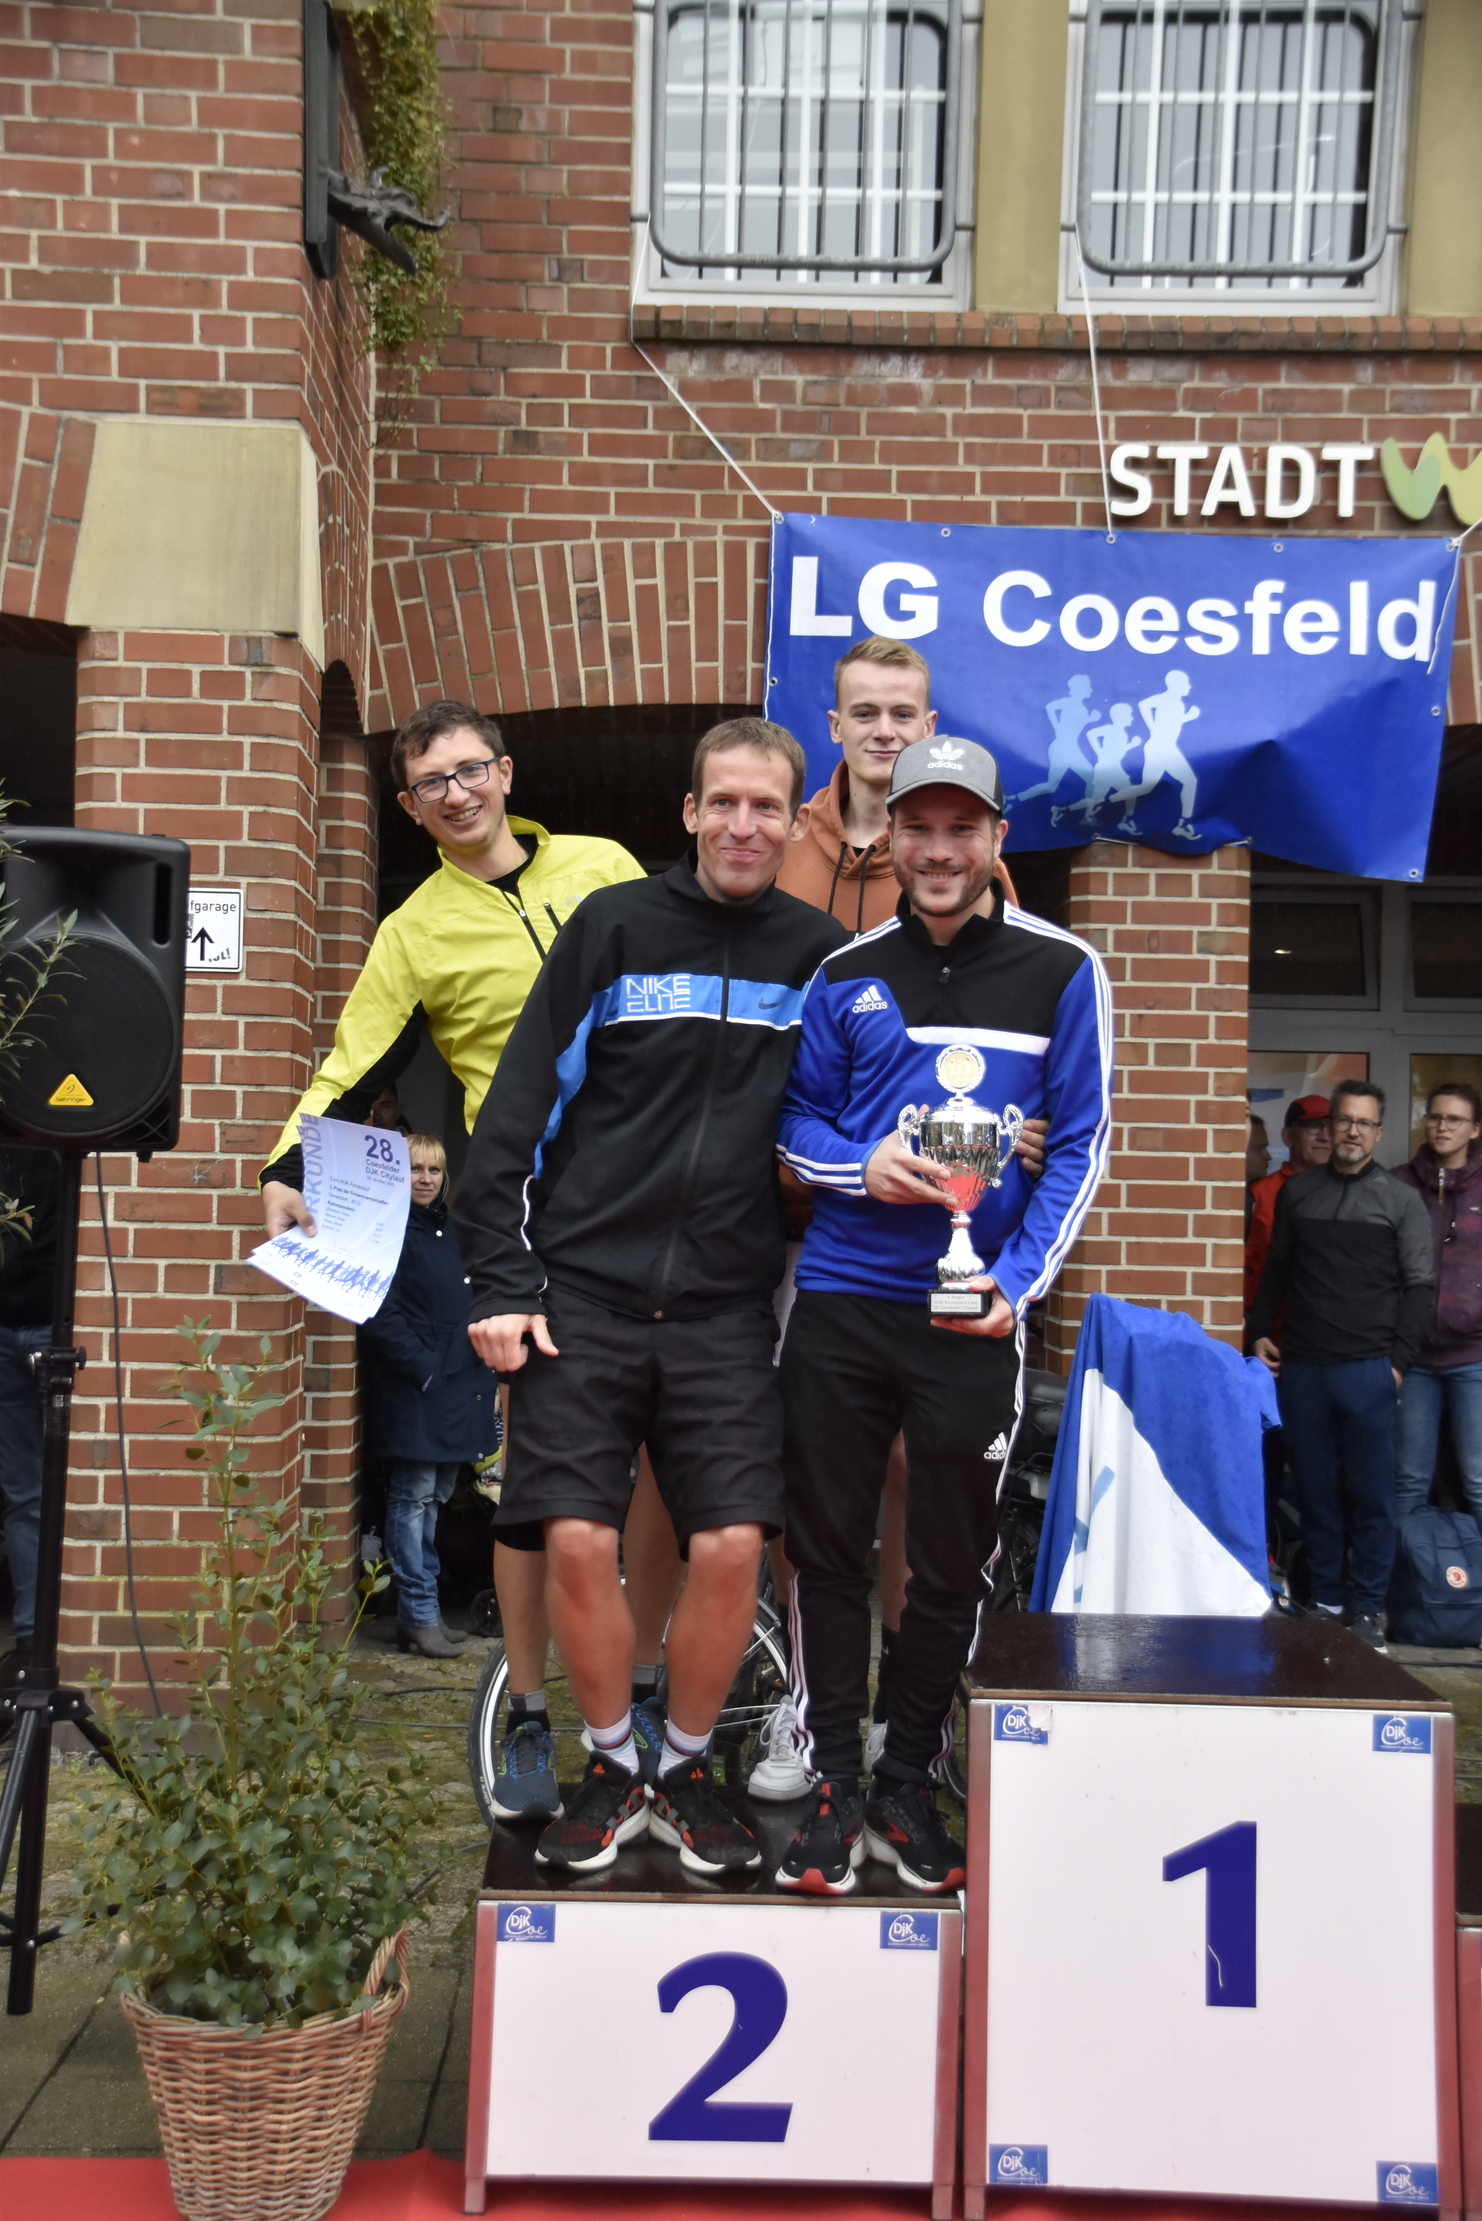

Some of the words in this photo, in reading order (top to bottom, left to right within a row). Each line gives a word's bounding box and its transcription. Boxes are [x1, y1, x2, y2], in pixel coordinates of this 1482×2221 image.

[789, 556, 939, 639] LG
[982, 570, 1436, 662] Coesfeld
[927, 761, 964, 771] adidas
[188, 900, 237, 915] fgarage
[626, 976, 691, 997] NIKE
[626, 994, 691, 1013] ELITE
[852, 1001, 888, 1013] adidas
[364, 1134, 401, 1165] 28.
[301, 1113, 324, 1214] RKUNDE
[365, 1158, 400, 1173] Coesfelder
[365, 1167, 379, 1176] DJK
[380, 1170, 405, 1183] Citylauf
[983, 1450, 1007, 1460] adid
[1163, 1821, 1258, 2009] 1
[648, 1951, 794, 2143] 2
